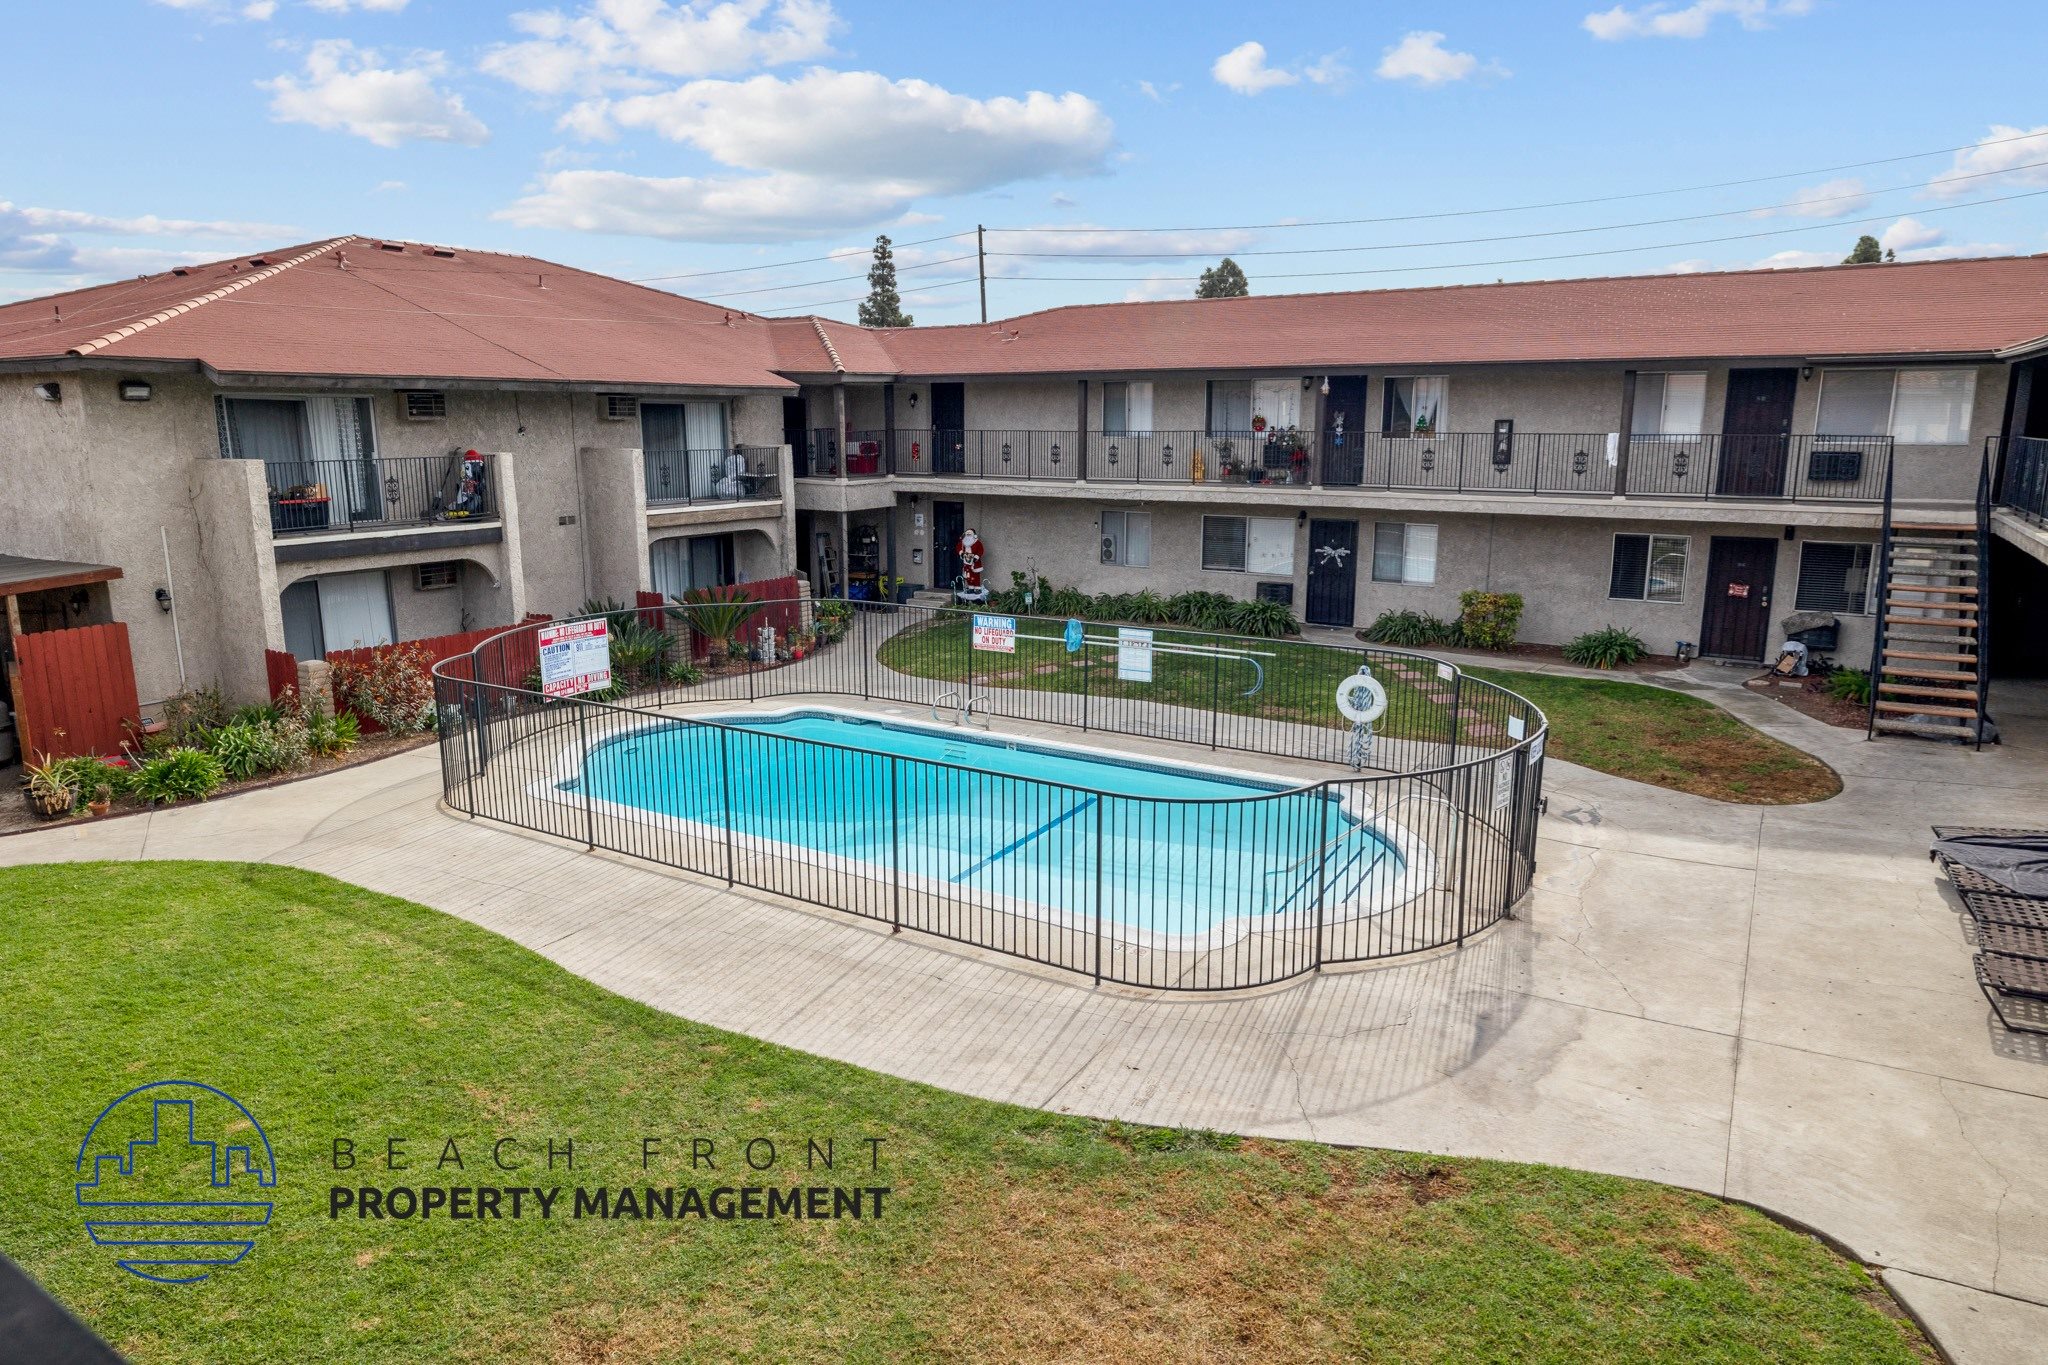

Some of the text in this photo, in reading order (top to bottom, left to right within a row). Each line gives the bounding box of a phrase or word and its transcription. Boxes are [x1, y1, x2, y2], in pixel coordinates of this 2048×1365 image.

[593, 620, 605, 630] DUTY
[977, 616, 1012, 629] WARNING
[975, 627, 1013, 637] NO LIFEGUARD
[992, 637, 1006, 645] DUTY
[542, 643, 571, 656] CAUTION
[577, 671, 608, 685] NO DIVING
[545, 678, 574, 693] CAPACITY
